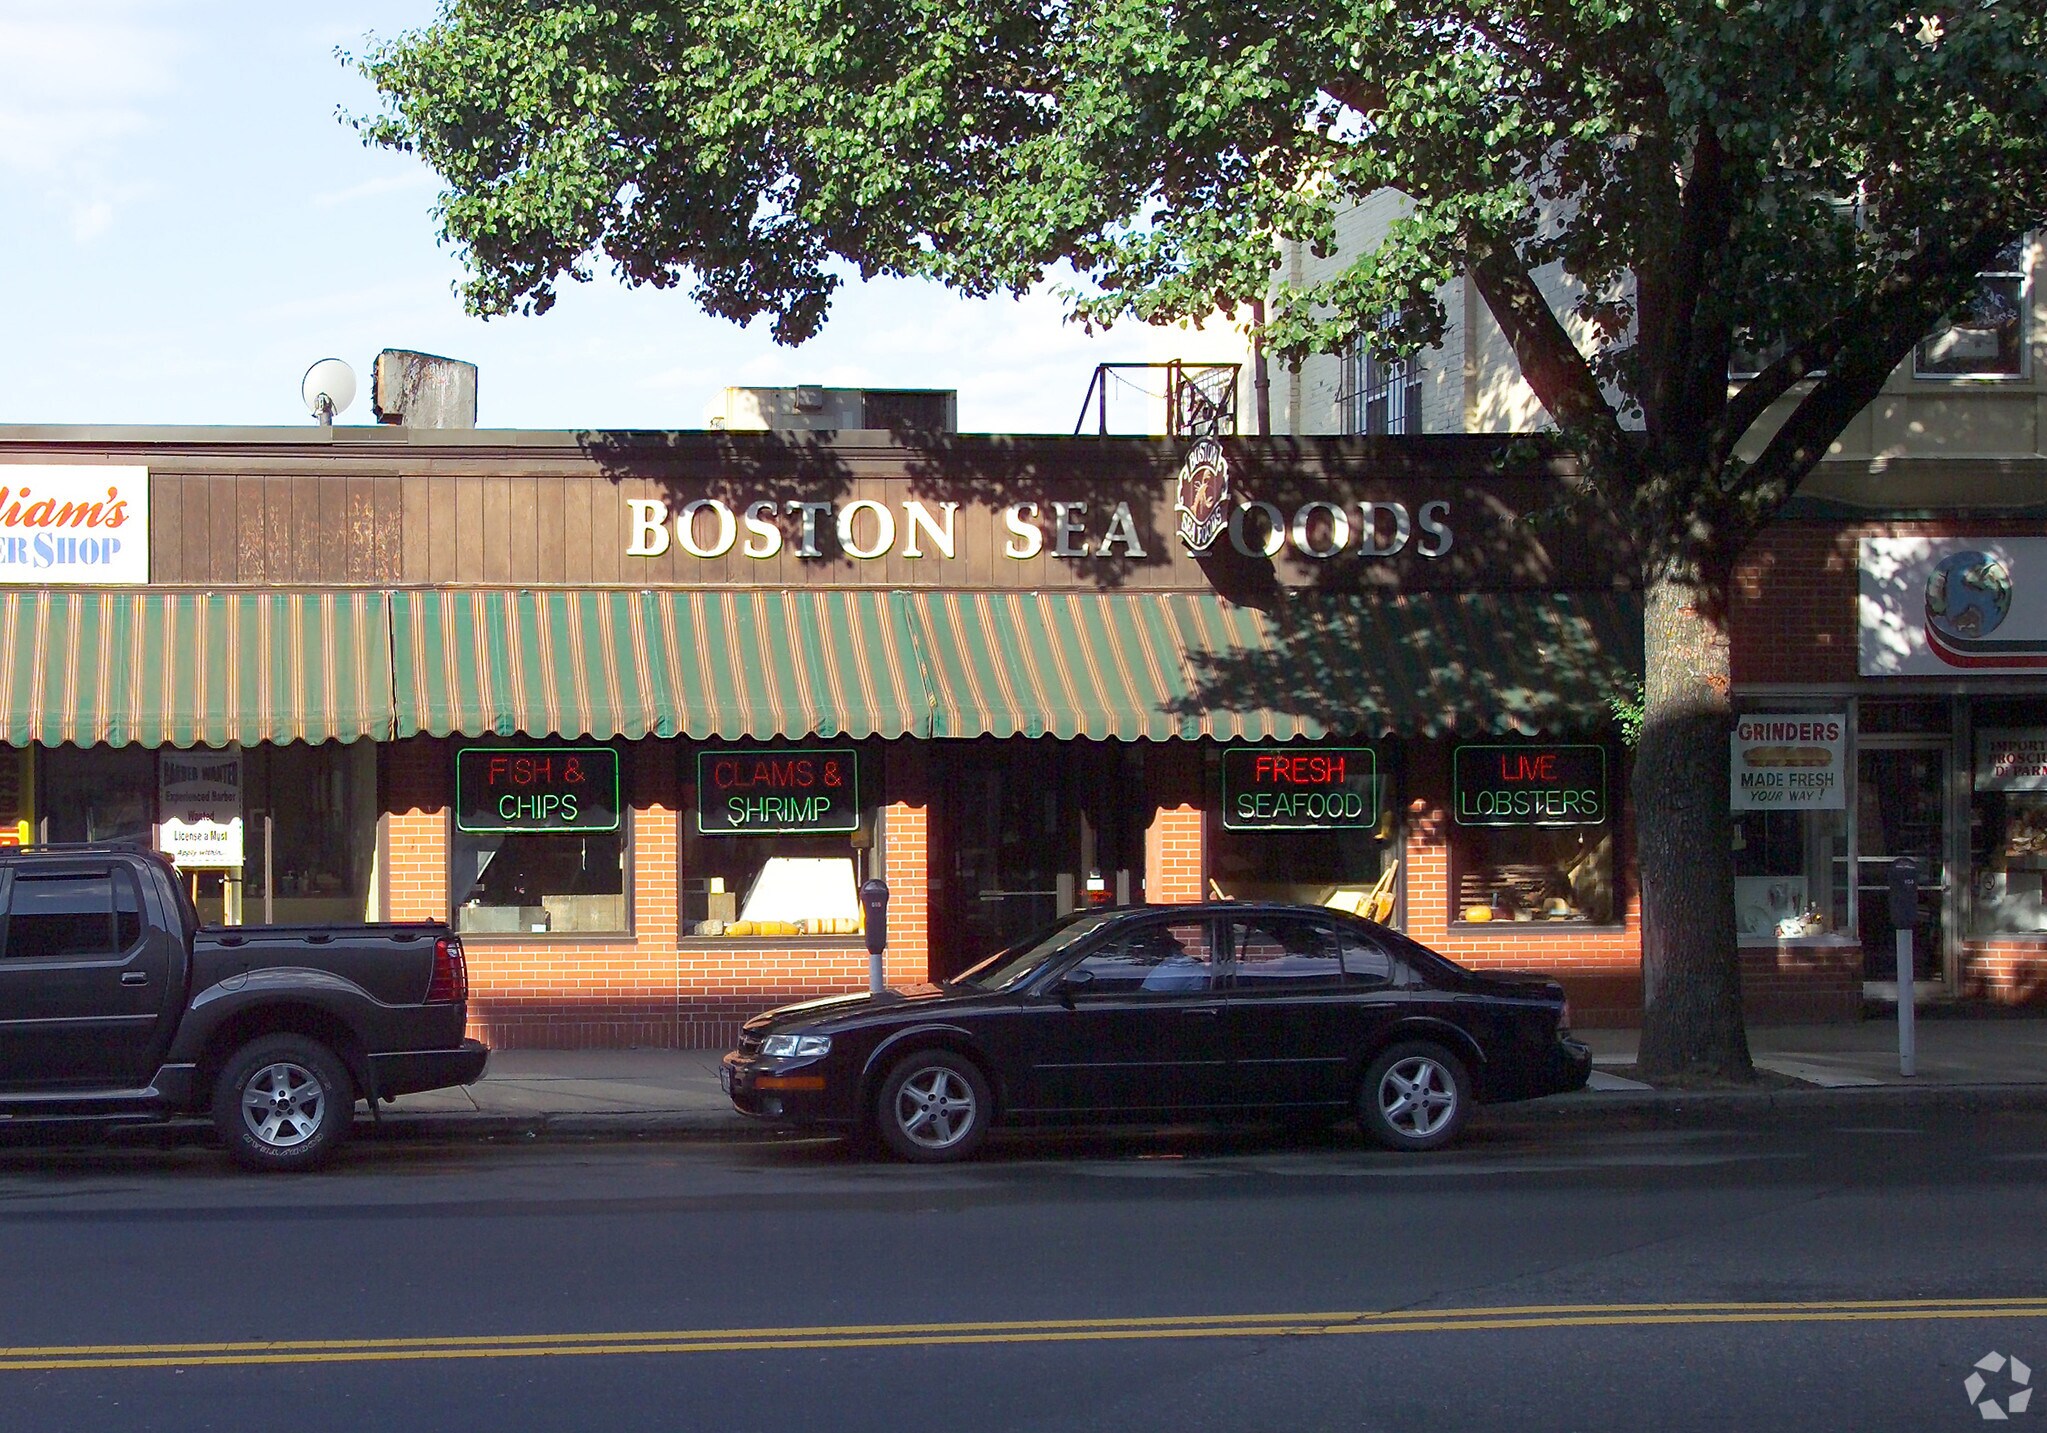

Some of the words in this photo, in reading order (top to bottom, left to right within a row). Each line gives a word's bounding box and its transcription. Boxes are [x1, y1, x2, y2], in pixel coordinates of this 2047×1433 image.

[1189, 442, 1218, 467] BOSTON
[626, 498, 960, 559] BOSTON
[1005, 501, 1148, 559] SEA
[1187, 500, 1455, 559] OODS
[0, 537, 29, 564] R
[33, 532, 121, 568] SHOP
[1738, 722, 1840, 741] GRINDERS
[488, 758, 551, 786] FISH
[563, 757, 586, 784] &
[713, 760, 814, 788] CLAMS
[823, 760, 842, 786] &
[1256, 756, 1346, 785] FRESH
[1502, 754, 1559, 782] LIVE
[1741, 772, 1784, 787] MADE
[1789, 772, 1834, 787] FRESH
[499, 794, 579, 821] CHIPS
[1237, 792, 1363, 819] SEAFOOD
[1461, 789, 1599, 816] LOBSTERS
[1750, 790, 1784, 802] YOUR
[728, 796, 831, 826] SHRIMP
[174, 830, 202, 841] License
